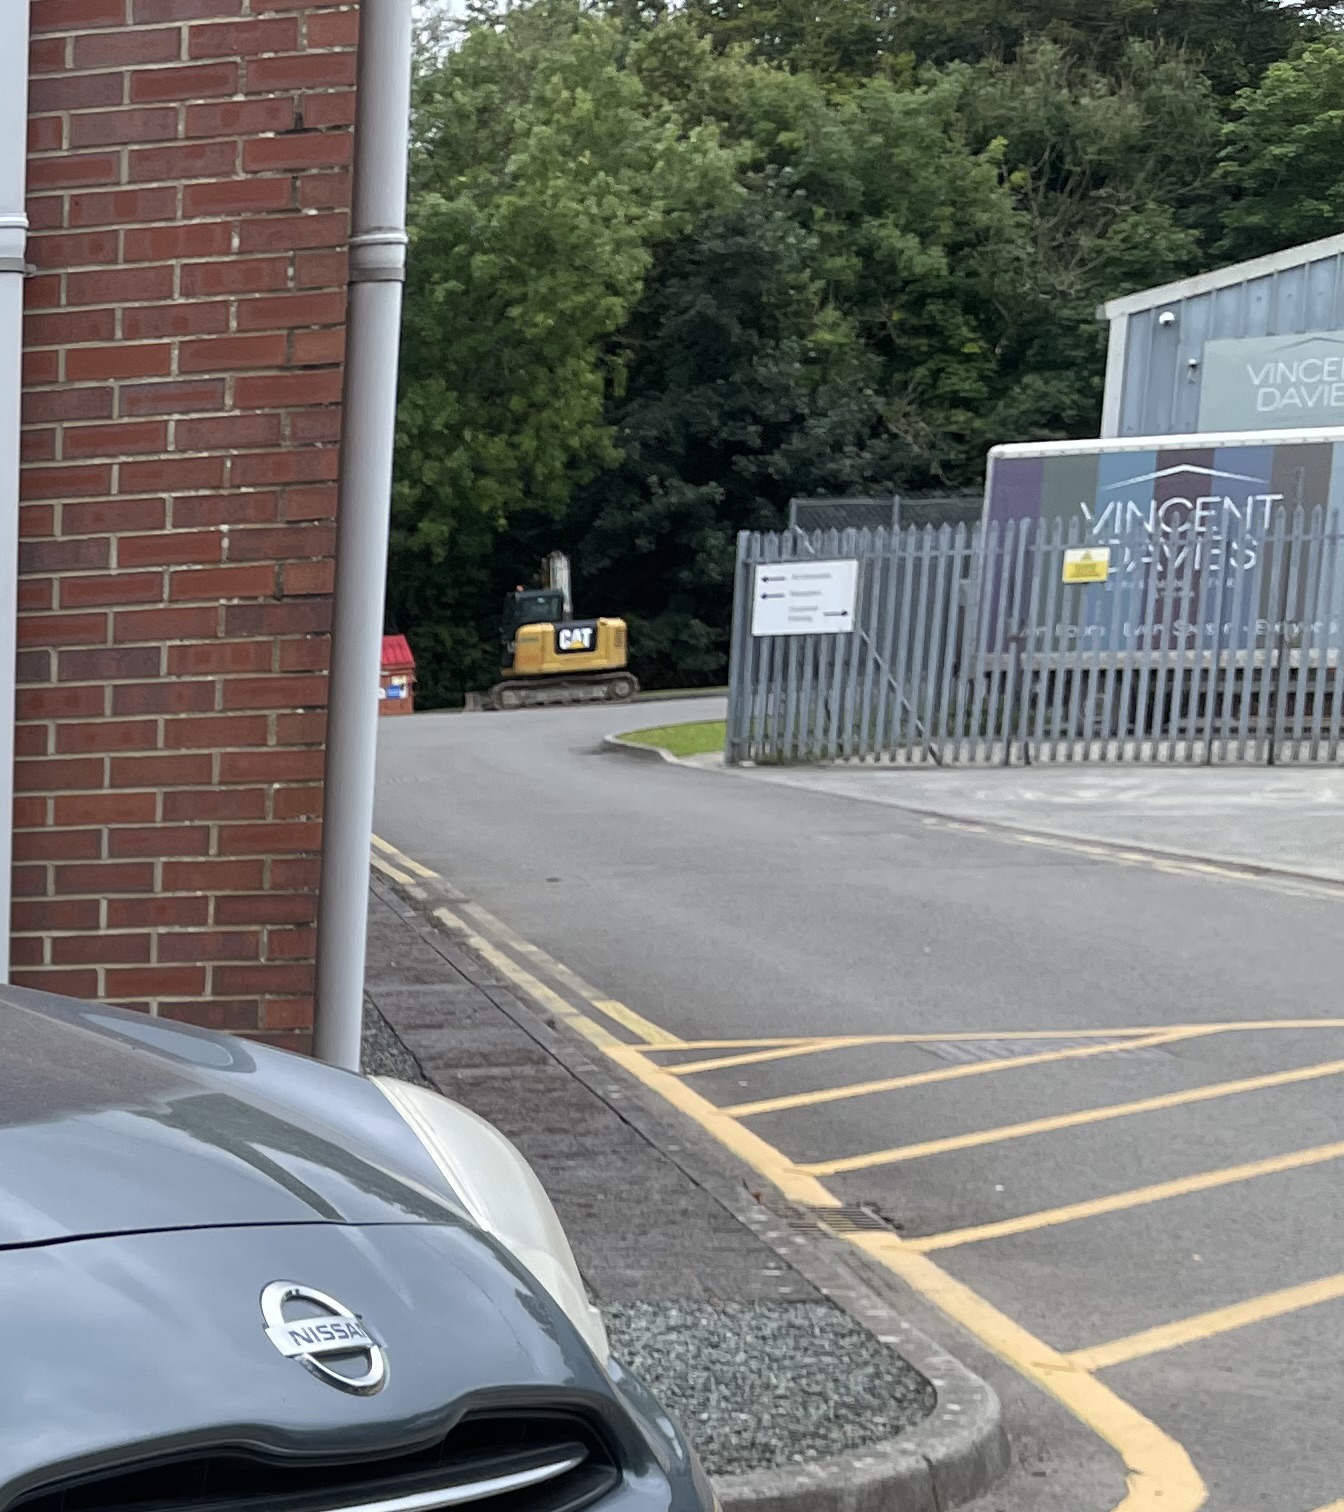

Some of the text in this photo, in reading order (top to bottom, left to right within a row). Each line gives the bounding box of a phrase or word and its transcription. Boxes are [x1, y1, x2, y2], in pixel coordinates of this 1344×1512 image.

[1246, 357, 1344, 385] VINCE
[1080, 493, 1284, 534] VINCENT
[558, 627, 593, 650] CAT
[288, 1321, 368, 1346] NISSAN
